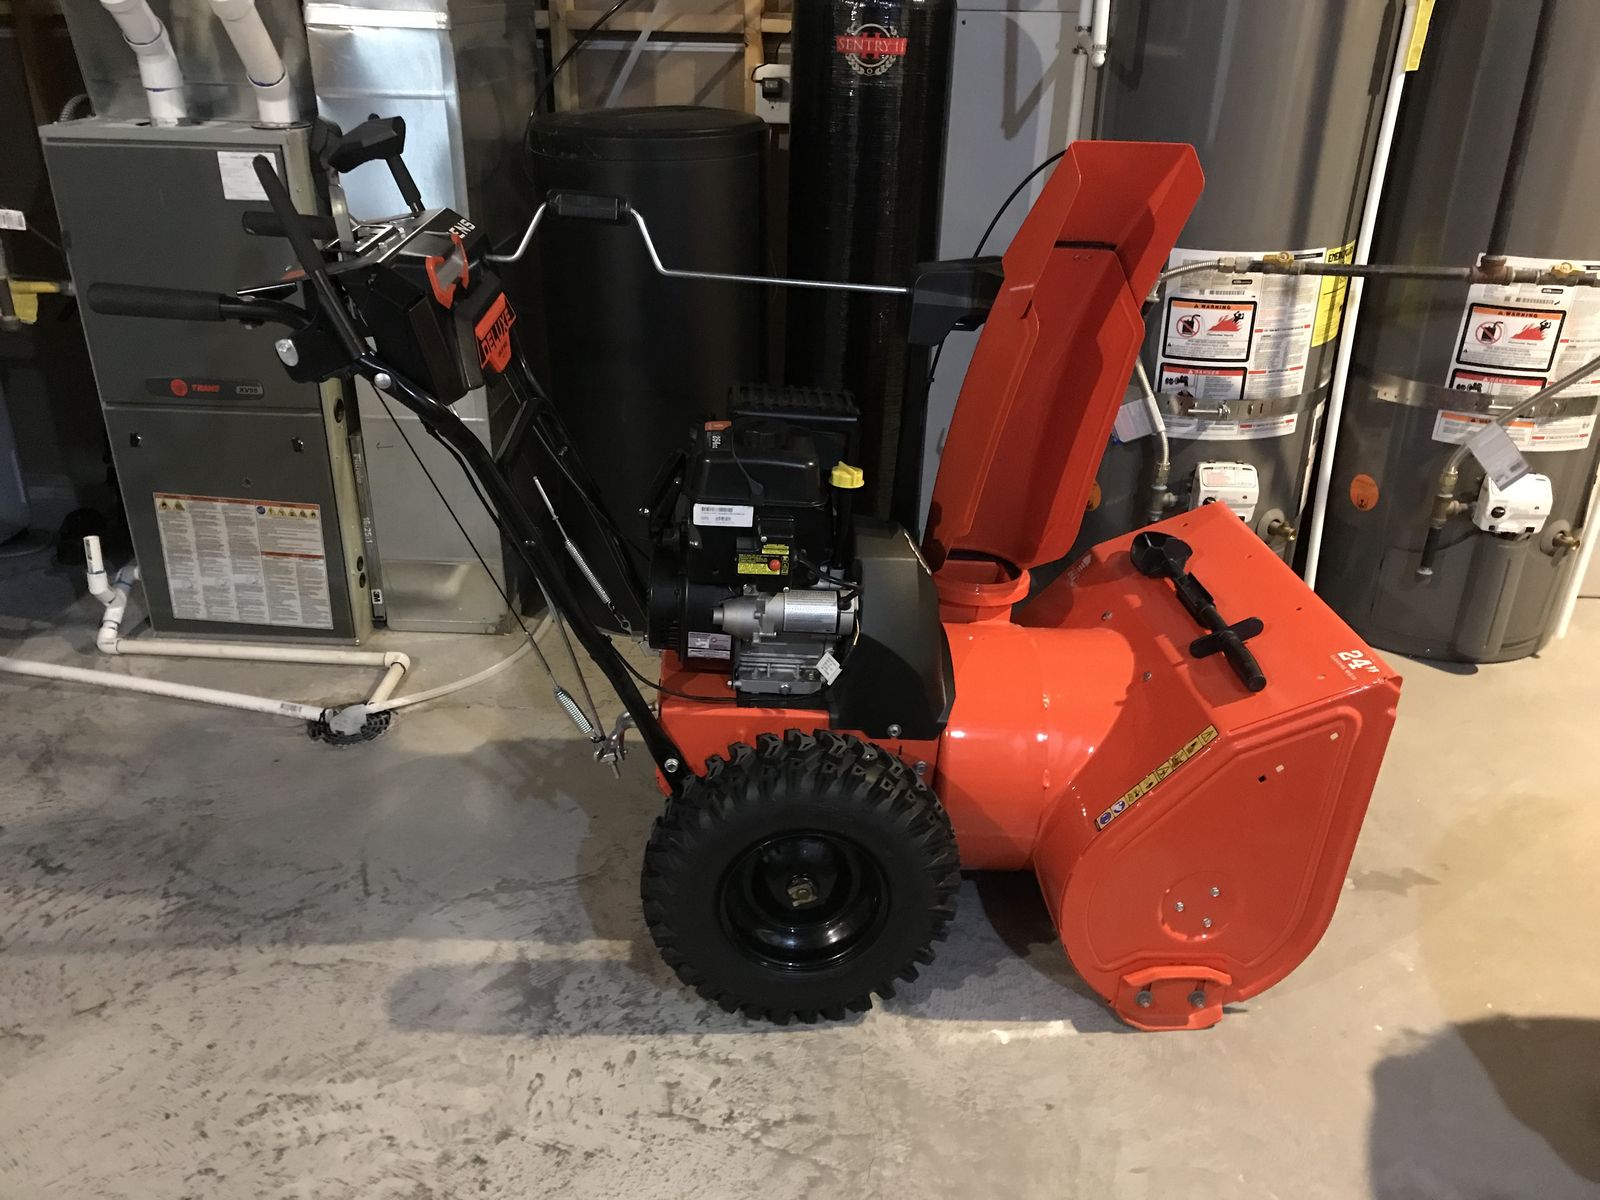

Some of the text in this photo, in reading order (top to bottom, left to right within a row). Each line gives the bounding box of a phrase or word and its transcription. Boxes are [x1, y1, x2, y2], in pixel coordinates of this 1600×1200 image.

[838, 38, 905, 53] SENTRY II
[1505, 311, 1539, 319] WARNING
[479, 304, 514, 360] DELUXE
[372, 591, 381, 603] 3M
